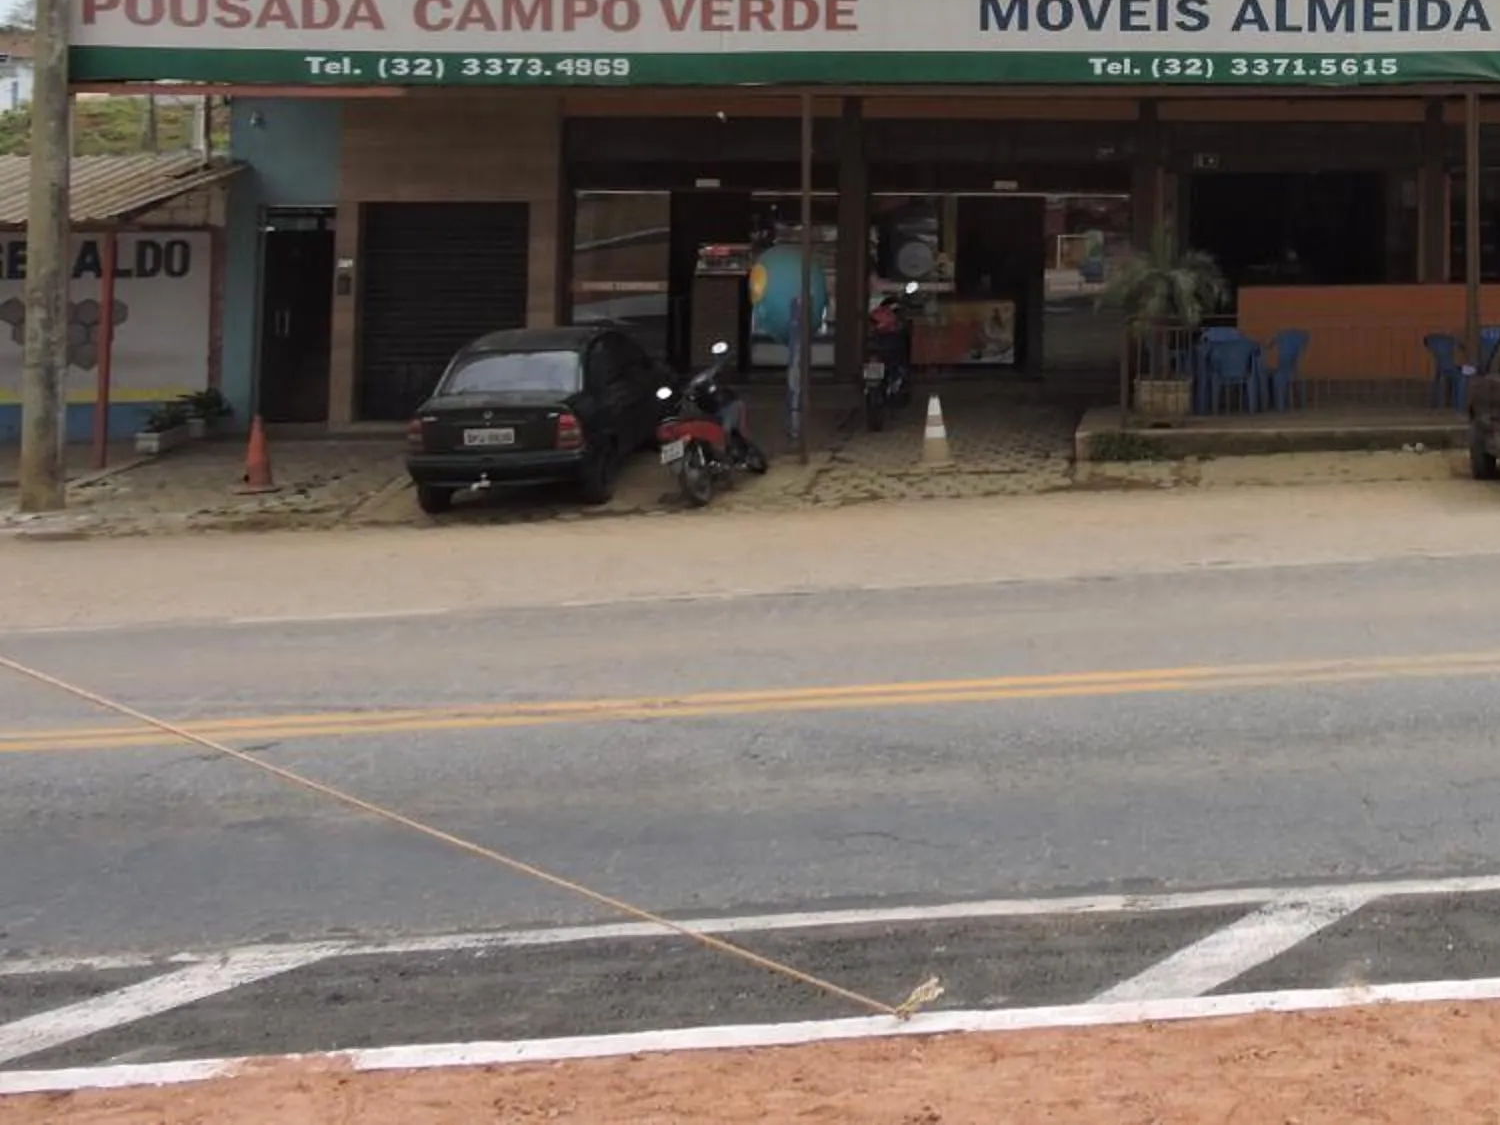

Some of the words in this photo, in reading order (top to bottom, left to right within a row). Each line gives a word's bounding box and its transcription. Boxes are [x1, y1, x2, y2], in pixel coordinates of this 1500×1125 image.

[305, 56, 361, 75] Tel.
[378, 57, 445, 79] (32)
[461, 57, 630, 77] 3373.4969
[1089, 57, 1140, 76] Tel.
[1151, 57, 1214, 79] (32)
[1231, 57, 1398, 76] 3371.5615
[0, 239, 191, 279] EALDO
